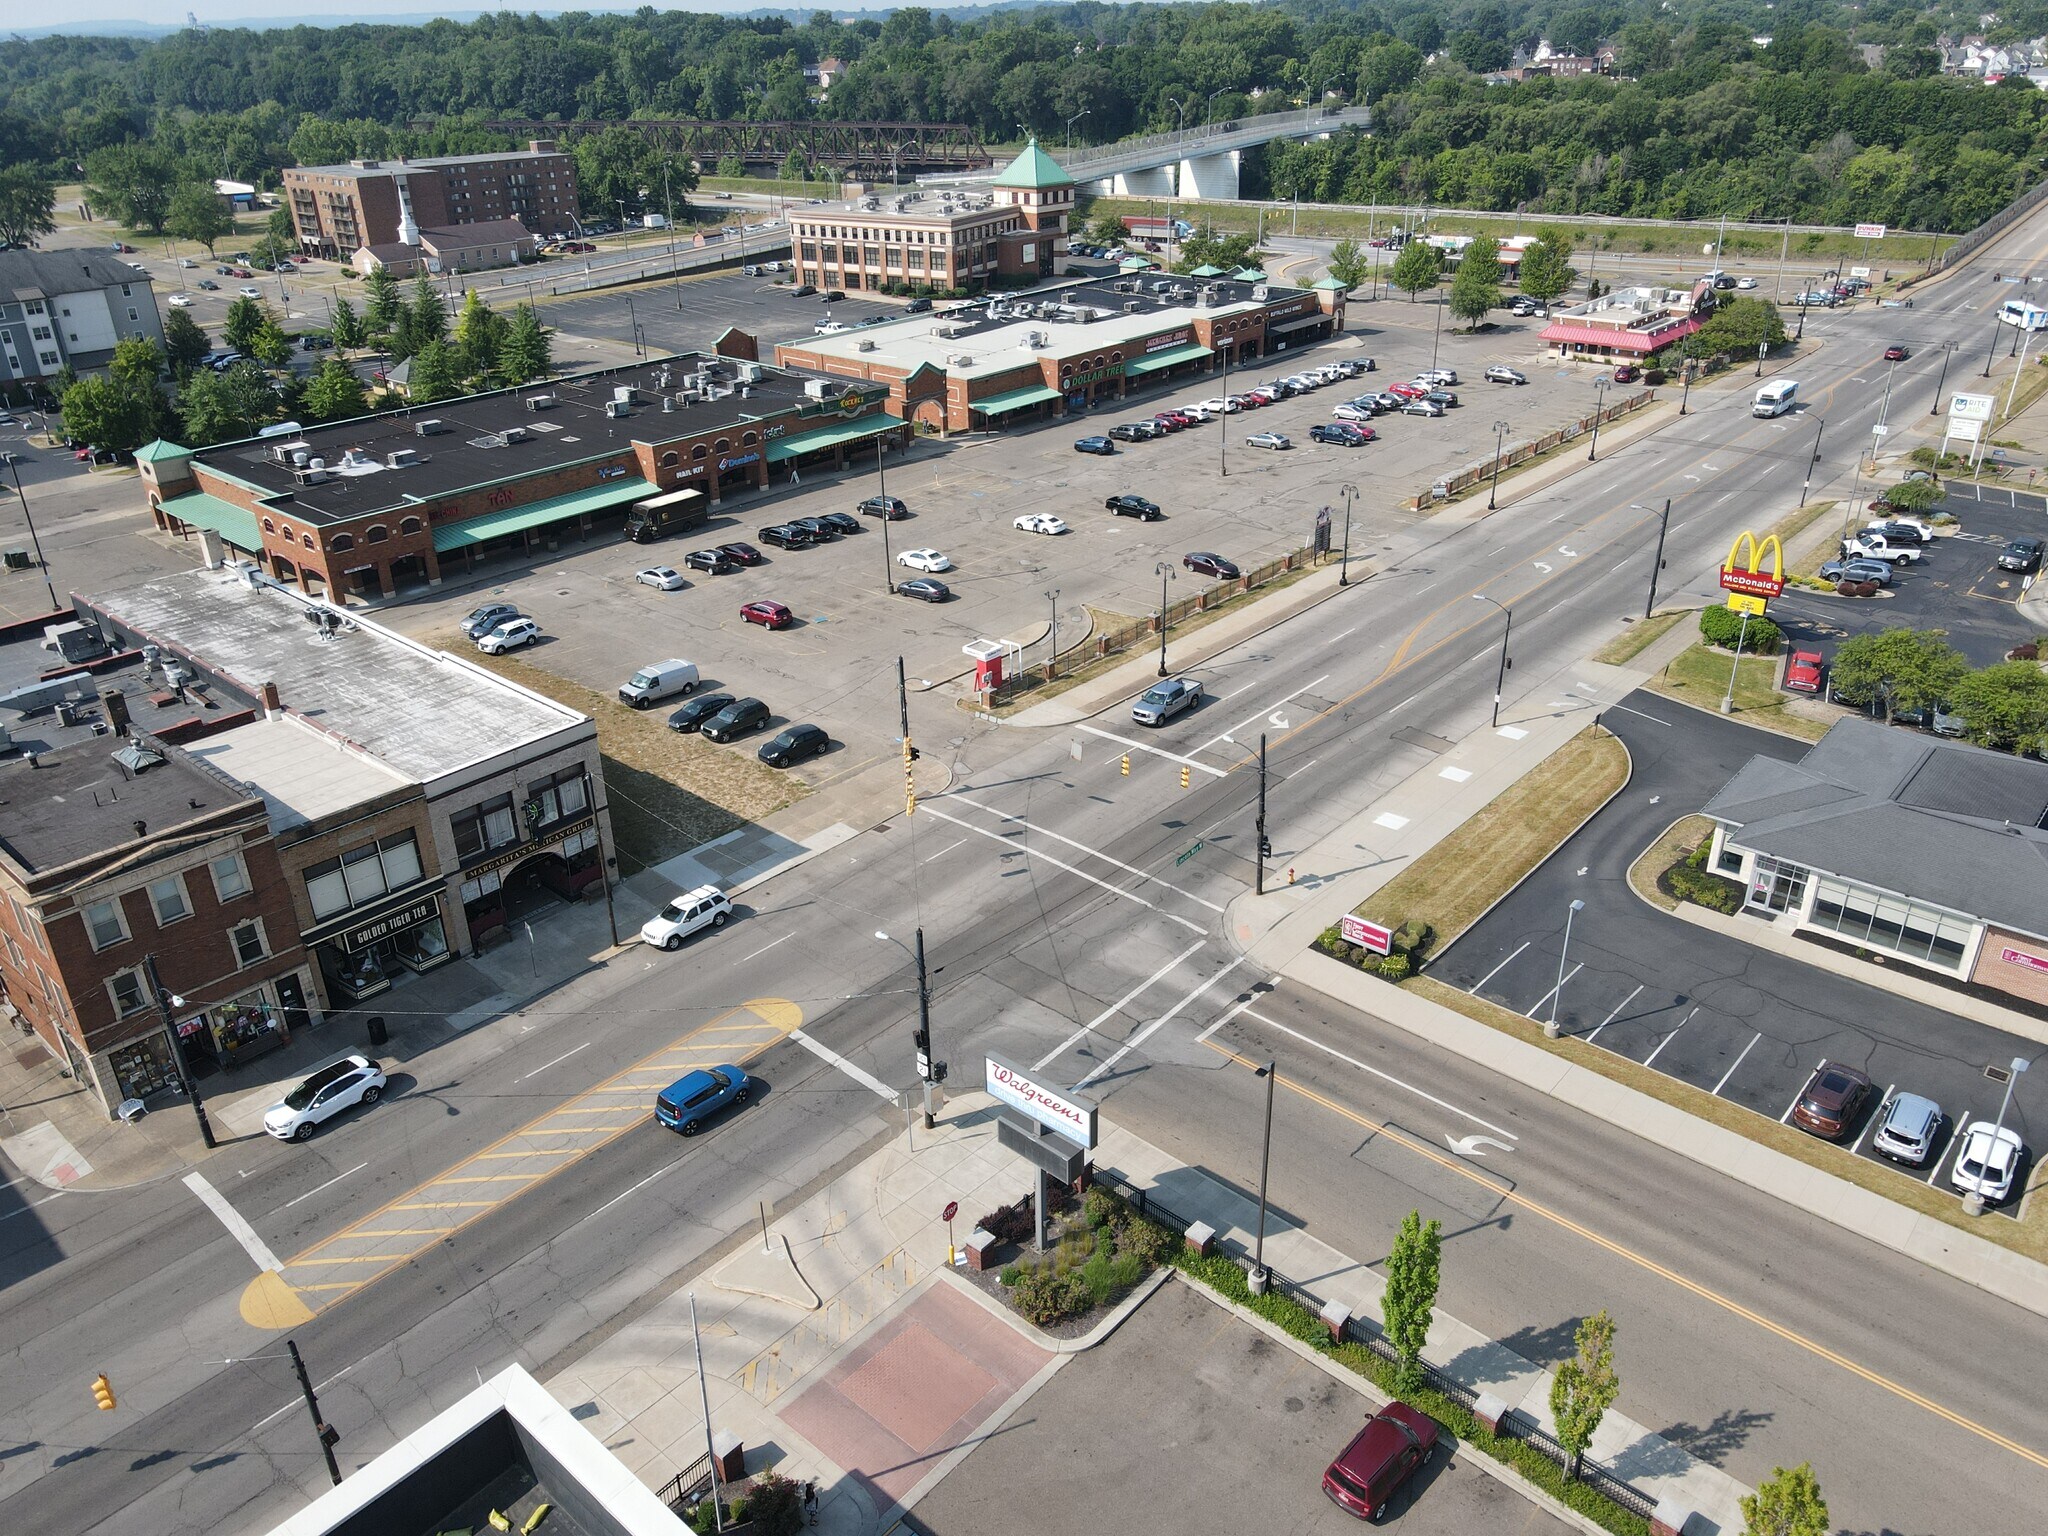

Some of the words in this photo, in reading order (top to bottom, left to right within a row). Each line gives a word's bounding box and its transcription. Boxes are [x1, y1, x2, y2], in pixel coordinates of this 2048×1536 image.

[1072, 371, 1103, 387] DOLLAR
[1105, 364, 1124, 377] TREE
[1968, 400, 1987, 408] RITE
[488, 489, 514, 506] TAN
[1723, 574, 1779, 591] McDonald's
[469, 848, 527, 878] MARGARITA'S
[566, 821, 590, 836] GRILL
[357, 922, 387, 944] GOLDEN
[388, 912, 411, 930] TIGER
[412, 905, 427, 920] TEA
[992, 1063, 1083, 1125] Walgreens
[994, 1086, 1016, 1104] drive
[1017, 1098, 1035, 1114] thru
[1037, 1108, 1081, 1140] pharmacy
[943, 1204, 957, 1220] STOP
